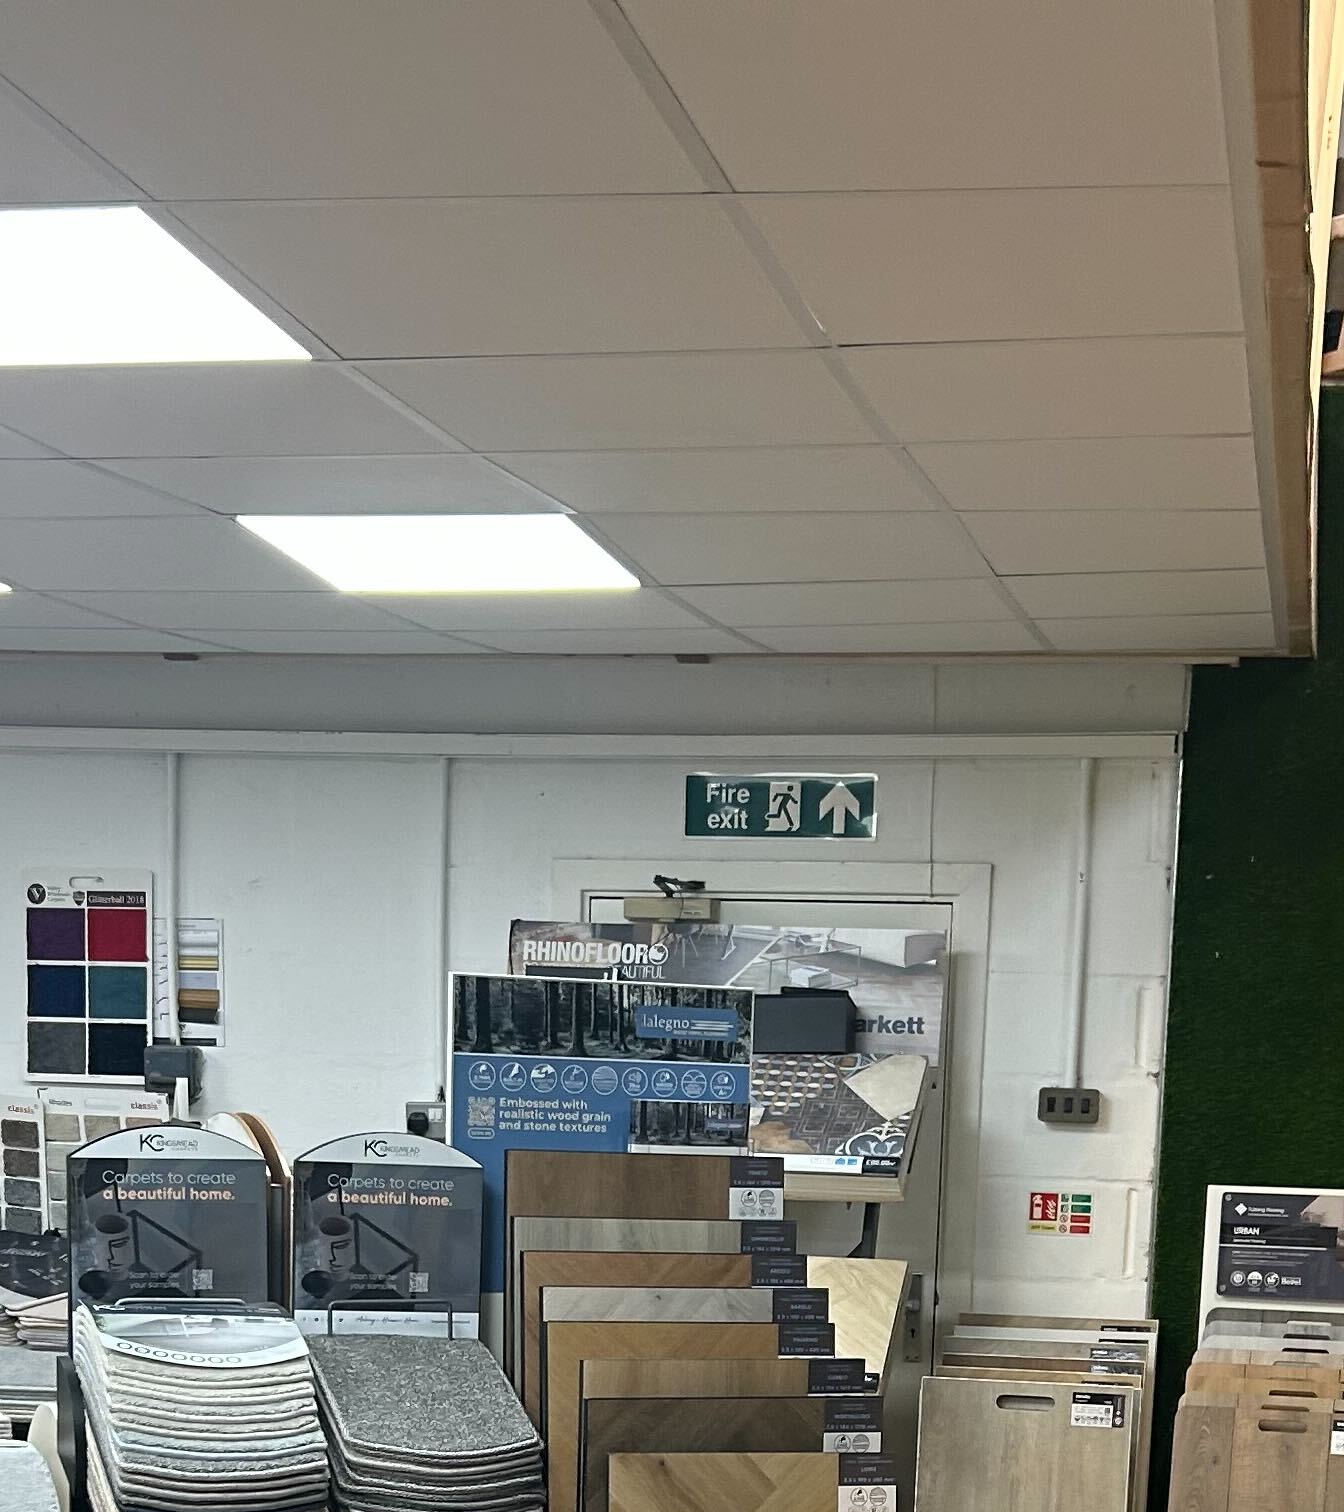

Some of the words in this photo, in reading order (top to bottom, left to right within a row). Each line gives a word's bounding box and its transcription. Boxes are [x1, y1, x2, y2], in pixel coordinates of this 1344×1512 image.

[706, 782, 751, 804] Fire
[707, 807, 749, 830] exit
[522, 939, 649, 965] RHINOFLOOR
[642, 1013, 690, 1032] lalegno
[855, 1015, 925, 1035] arkett
[499, 1097, 559, 1109] Embossed
[562, 1099, 588, 1110] with
[499, 1108, 551, 1120] realistic
[554, 1110, 579, 1122] wood
[582, 1111, 612, 1124] grain
[499, 1120, 521, 1131] and
[523, 1122, 557, 1132] stone
[558, 1122, 607, 1133] textures
[102, 1170, 164, 1186] Carpets
[167, 1172, 184, 1185] to
[187, 1172, 237, 1185] create
[327, 1173, 386, 1191] Carpets
[389, 1177, 405, 1188] to
[407, 1178, 454, 1191] create
[103, 1189, 113, 1200] a
[117, 1187, 186, 1201] beautiful
[190, 1188, 235, 1201] home.
[327, 1193, 338, 1203] a
[341, 1191, 406, 1206] beautiful
[410, 1192, 453, 1207] home.
